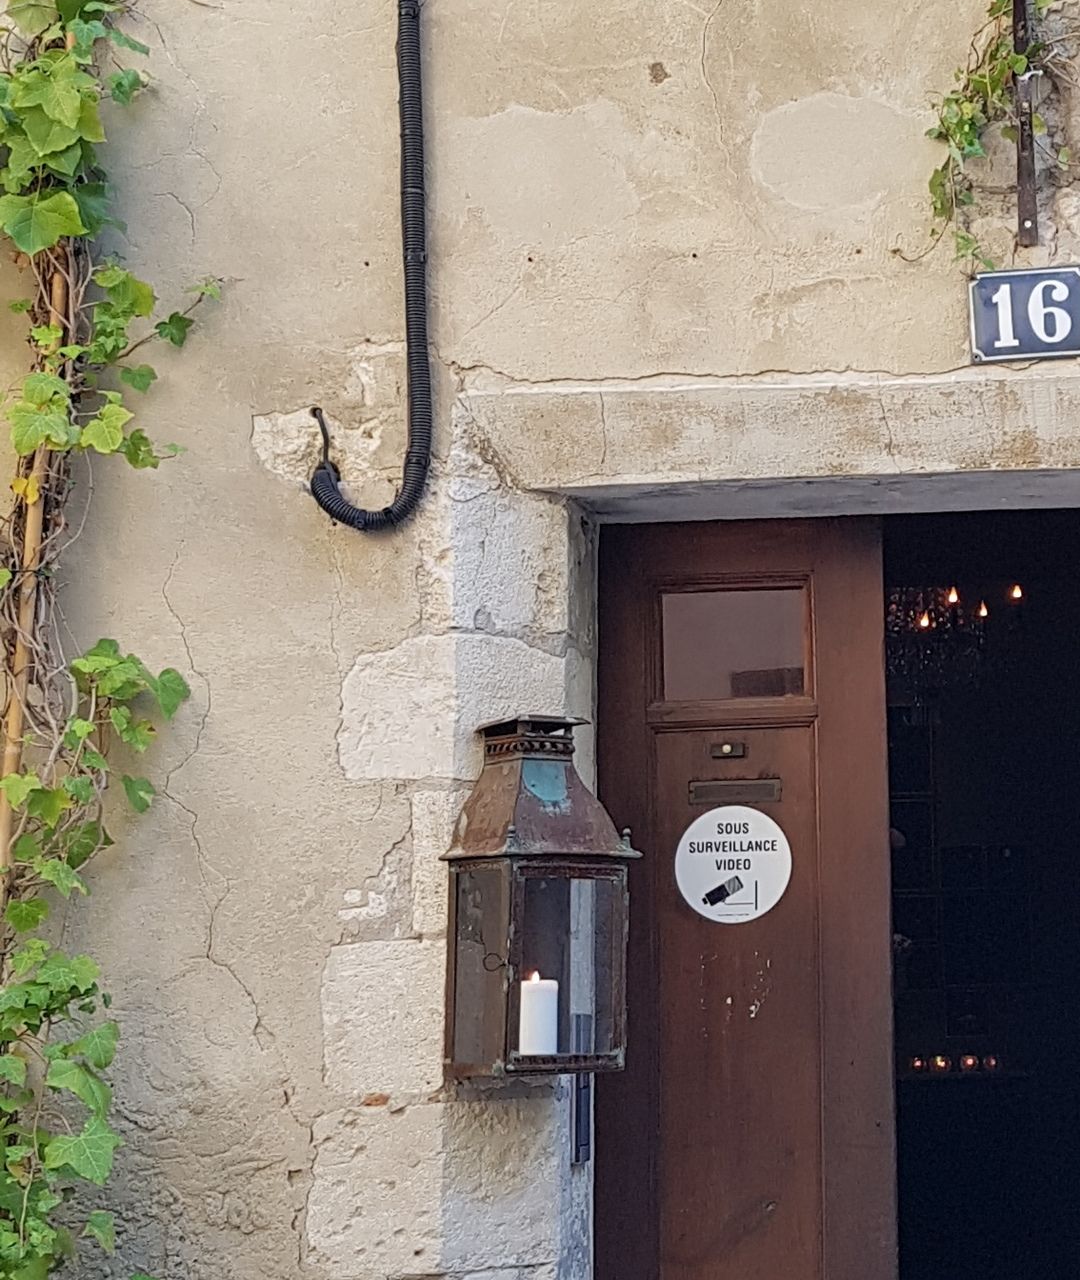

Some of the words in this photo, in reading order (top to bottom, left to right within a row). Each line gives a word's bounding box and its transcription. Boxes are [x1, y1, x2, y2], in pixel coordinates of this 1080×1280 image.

[991, 279, 1072, 348] 16
[716, 822, 750, 835] SOUS
[688, 839, 778, 854] SURVEILLANCE
[715, 858, 752, 871] VIDEO
